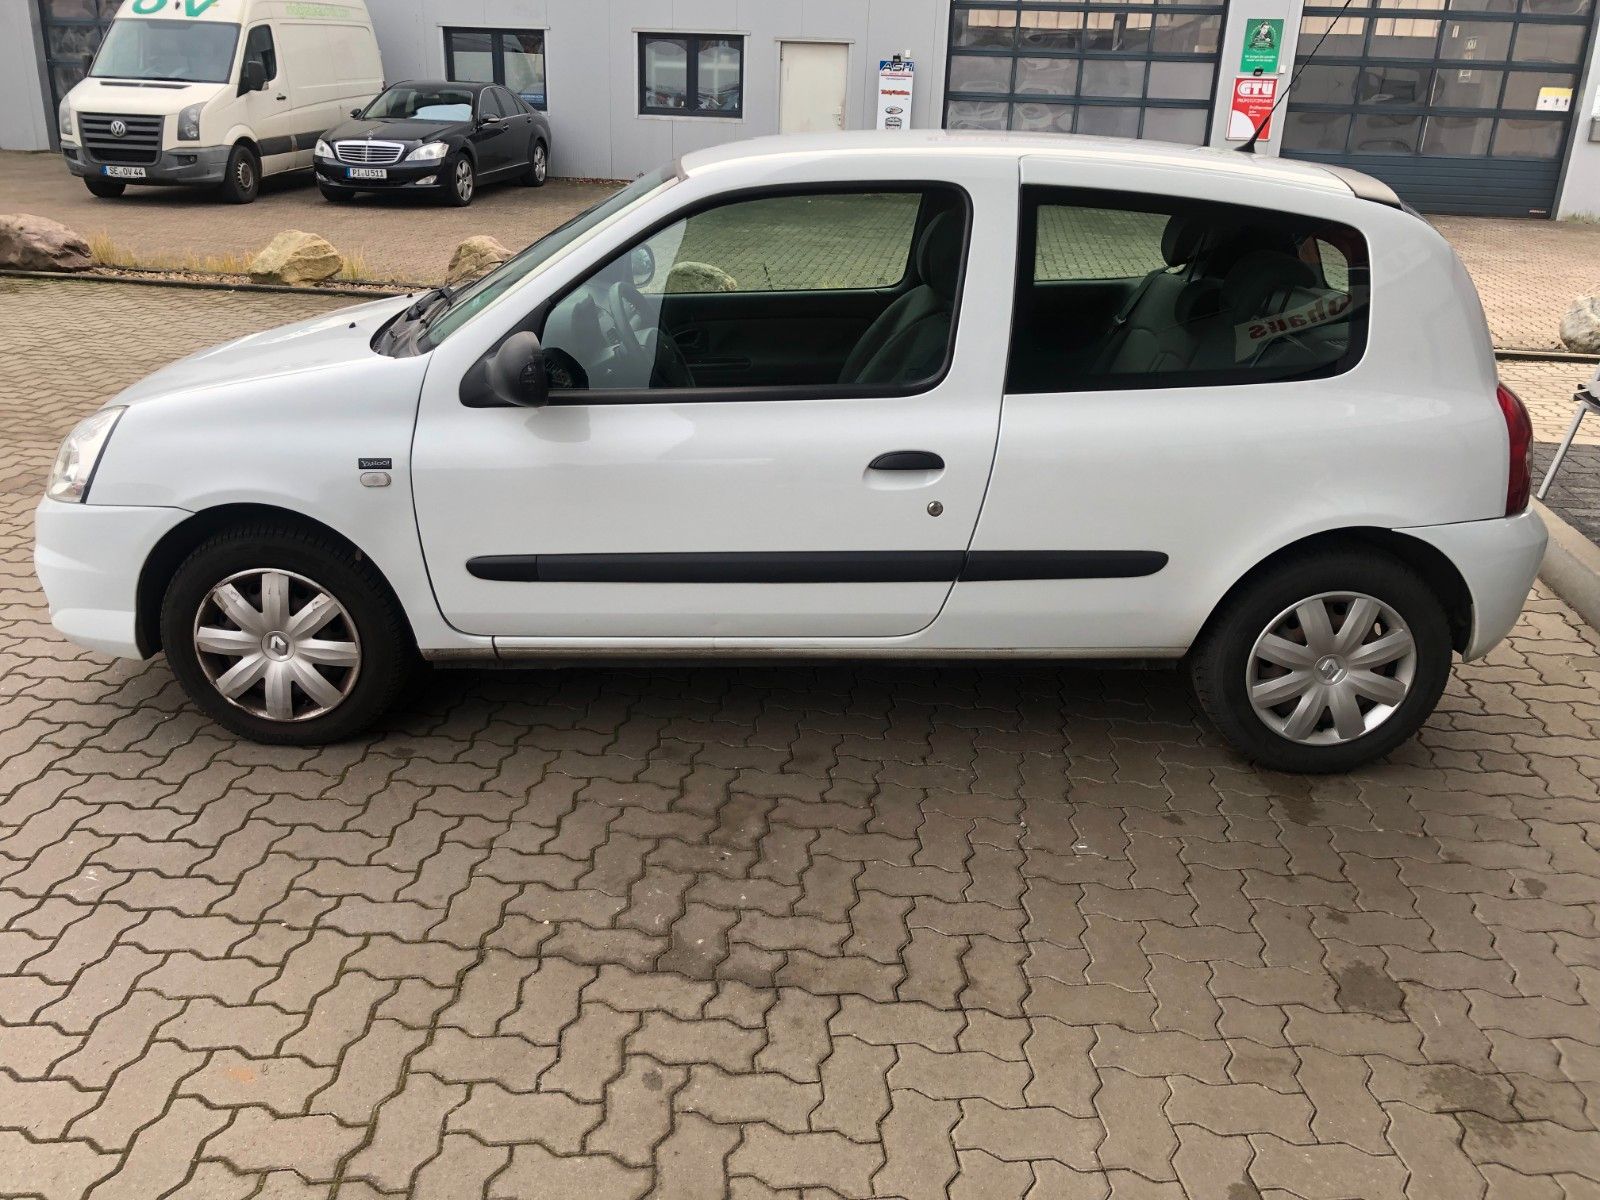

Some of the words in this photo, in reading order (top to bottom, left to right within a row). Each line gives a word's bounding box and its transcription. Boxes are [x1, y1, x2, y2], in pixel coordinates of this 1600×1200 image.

[881, 62, 914, 72] ASH
[109, 167, 118, 175] SE
[133, 168, 143, 176] 44
[352, 169, 360, 177] PI
